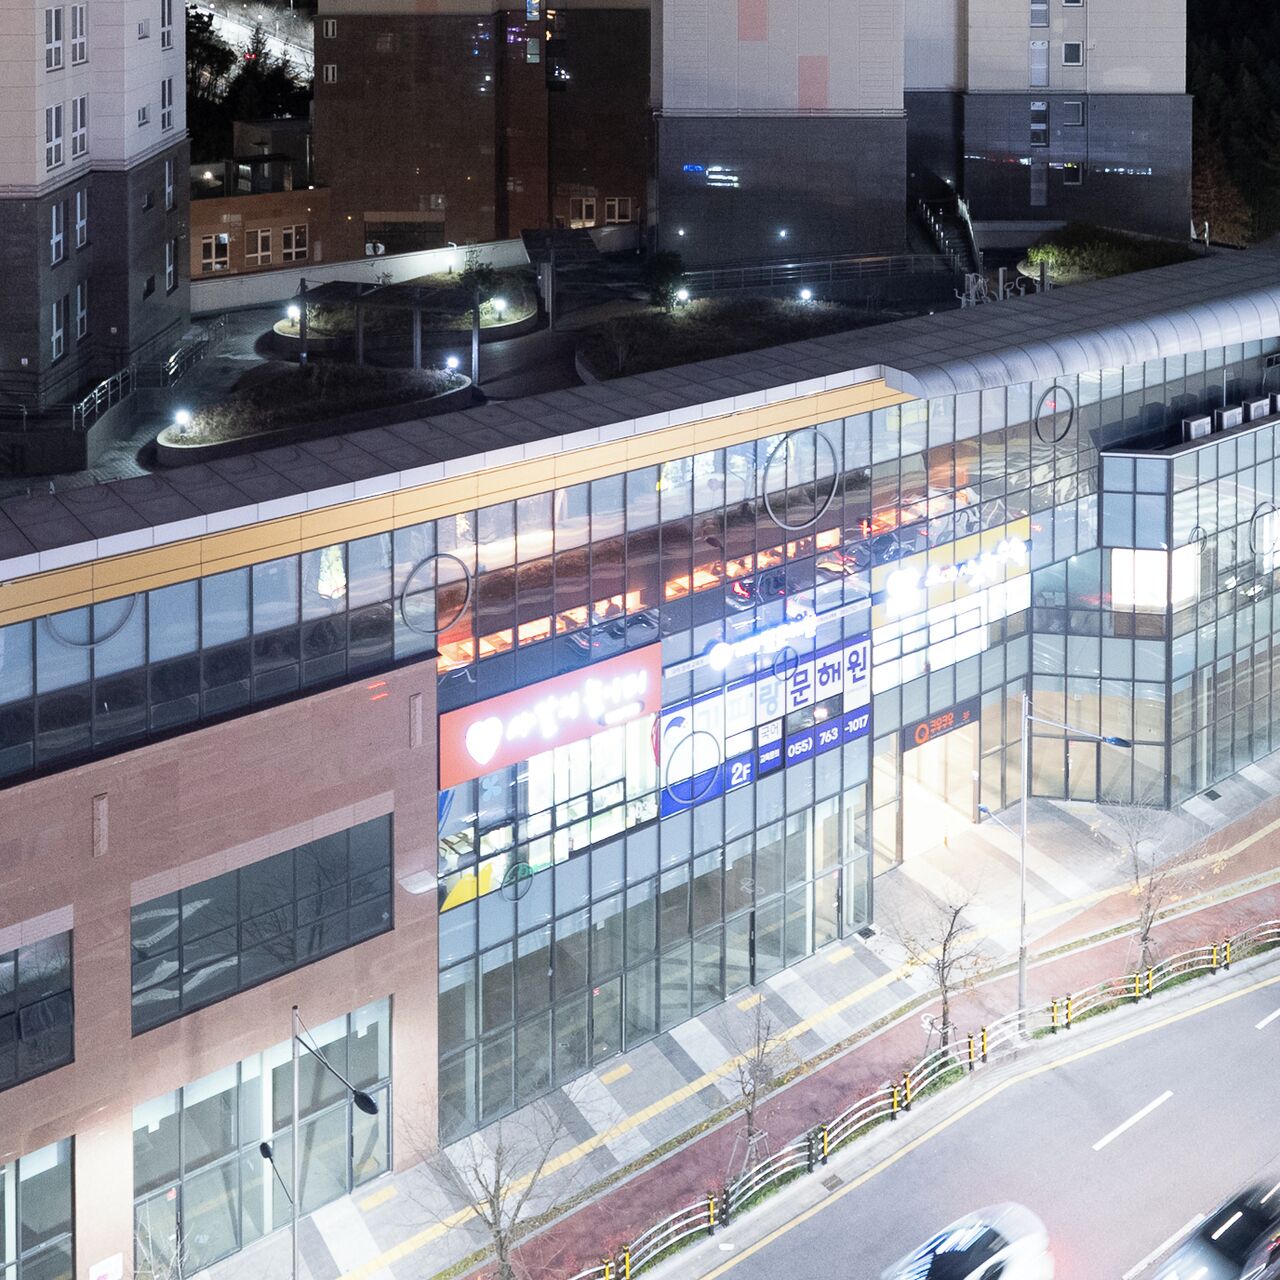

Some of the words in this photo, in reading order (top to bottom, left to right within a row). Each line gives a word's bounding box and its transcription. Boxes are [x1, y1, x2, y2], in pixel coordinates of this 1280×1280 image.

[788, 737, 813, 758] 055)
[819, 727, 838, 745] 763
[731, 762, 752, 785] 2F
